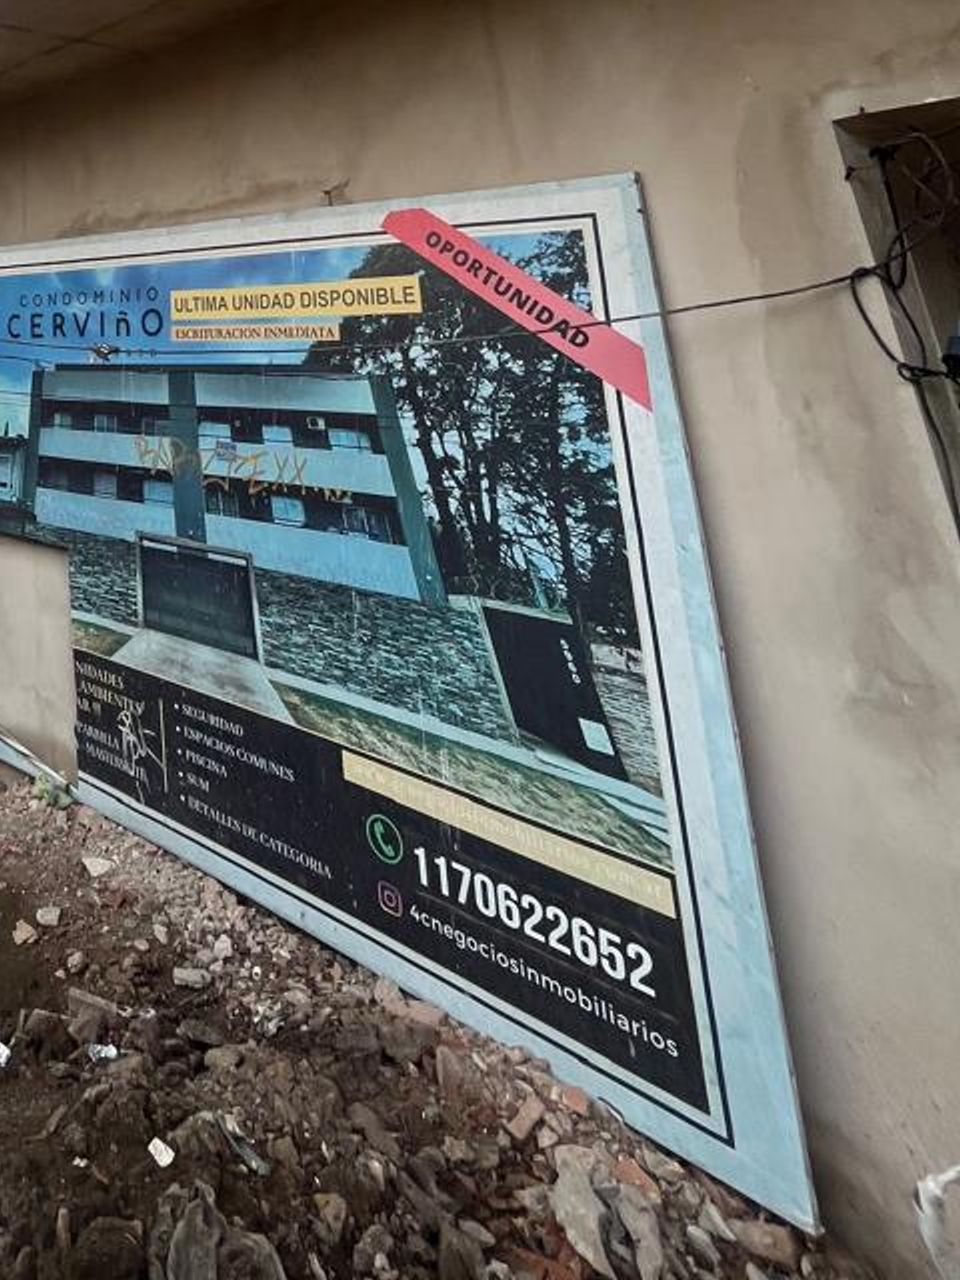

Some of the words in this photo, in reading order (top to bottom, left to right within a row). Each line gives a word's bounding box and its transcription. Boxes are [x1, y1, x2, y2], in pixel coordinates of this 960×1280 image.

[19, 286, 159, 308] CONDOMINIO
[173, 295, 228, 313] ULTIMA
[231, 292, 296, 311] UNIDAD
[299, 285, 417, 309] DISPONIBLE
[425, 230, 590, 349] OPORTUNIDAD
[263, 324, 336, 340] INMEDIATA
[181, 703, 244, 738] SEGURIDAD
[183, 724, 236, 757] ESPACIOS
[236, 746, 296, 783] COMUNES
[185, 748, 228, 778] PISCINA
[186, 771, 210, 793] SUM
[187, 794, 241, 832] DETALLES
[241, 824, 259, 842] DE
[259, 832, 332, 880] CATEGORIA
[413, 846, 657, 998] 1170622652
[409, 903, 680, 1058] 4cnegociosinmobiliarios
